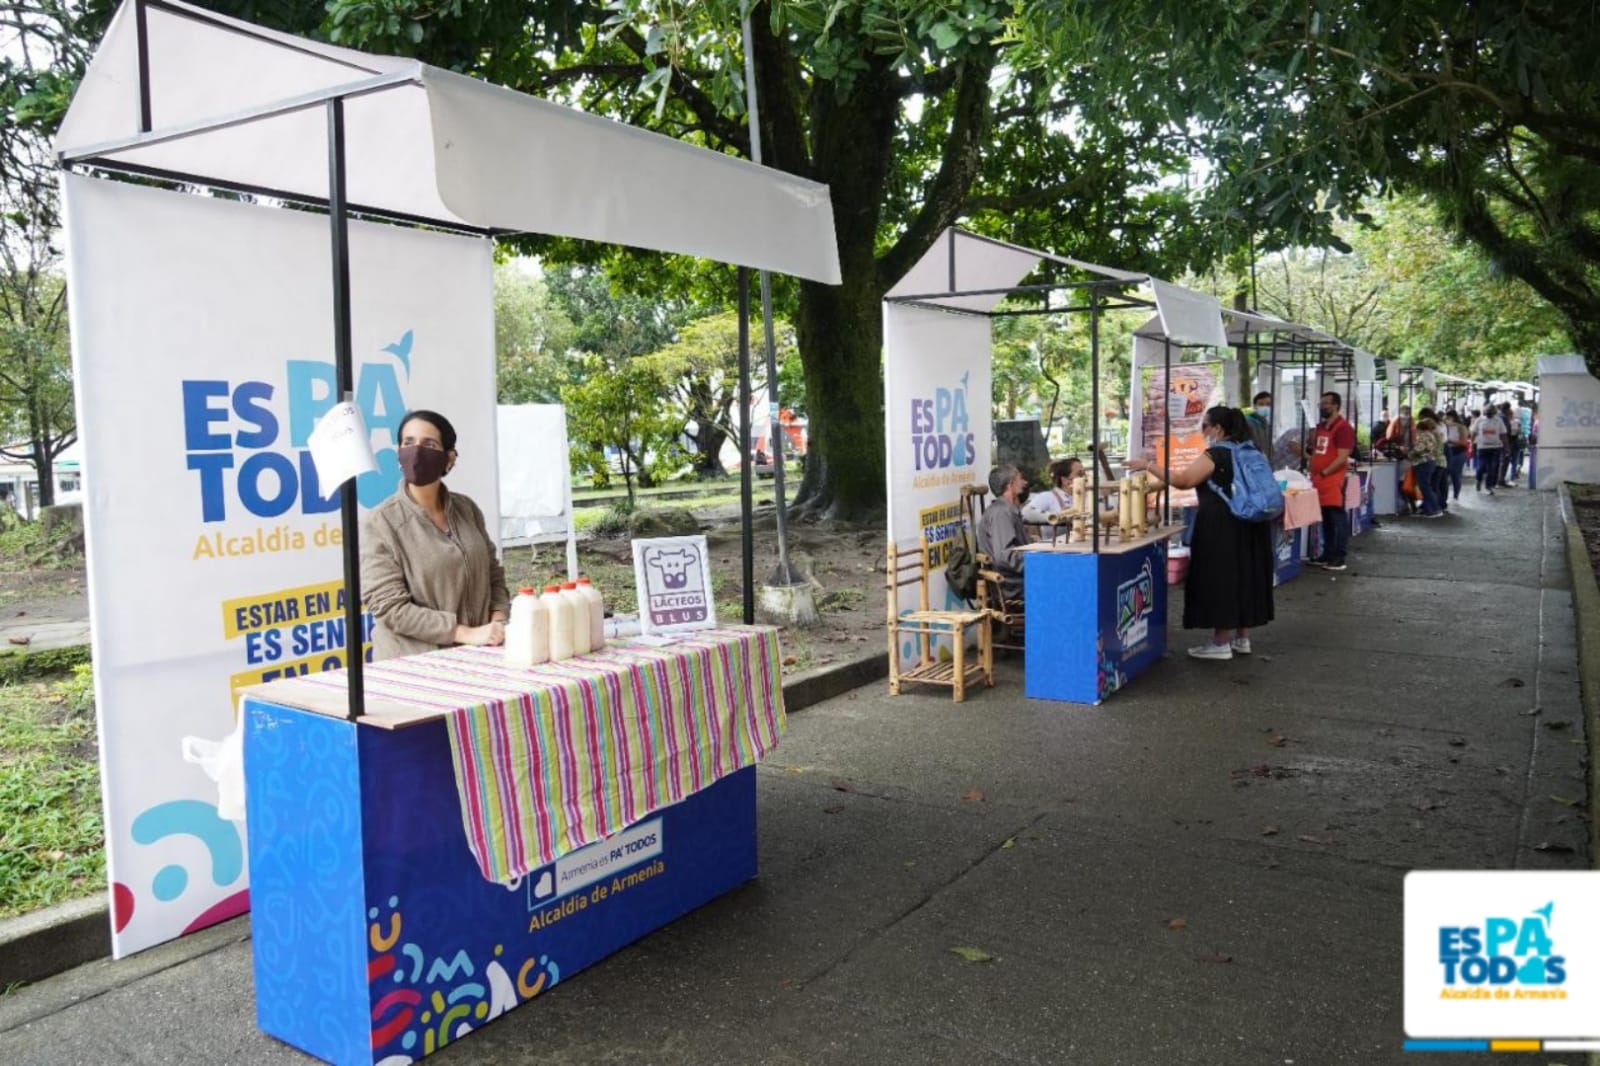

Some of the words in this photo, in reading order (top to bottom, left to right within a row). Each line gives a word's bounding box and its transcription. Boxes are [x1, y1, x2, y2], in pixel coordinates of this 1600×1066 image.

[182, 380, 279, 450] ES
[911, 399, 934, 434] ES
[936, 388, 968, 432] PA
[912, 433, 975, 470] TODOS
[192, 524, 306, 561] Alcaldía
[313, 522, 342, 548] de
[235, 597, 299, 631] ESTAR
[305, 591, 330, 616] EN
[655, 610, 704, 624] BLUS
[246, 629, 282, 665] ES
[561, 860, 598, 882] Armenia
[599, 857, 609, 868] es
[625, 833, 657, 855] TODOS
[528, 895, 588, 934] Alcaldía
[591, 885, 608, 903] de
